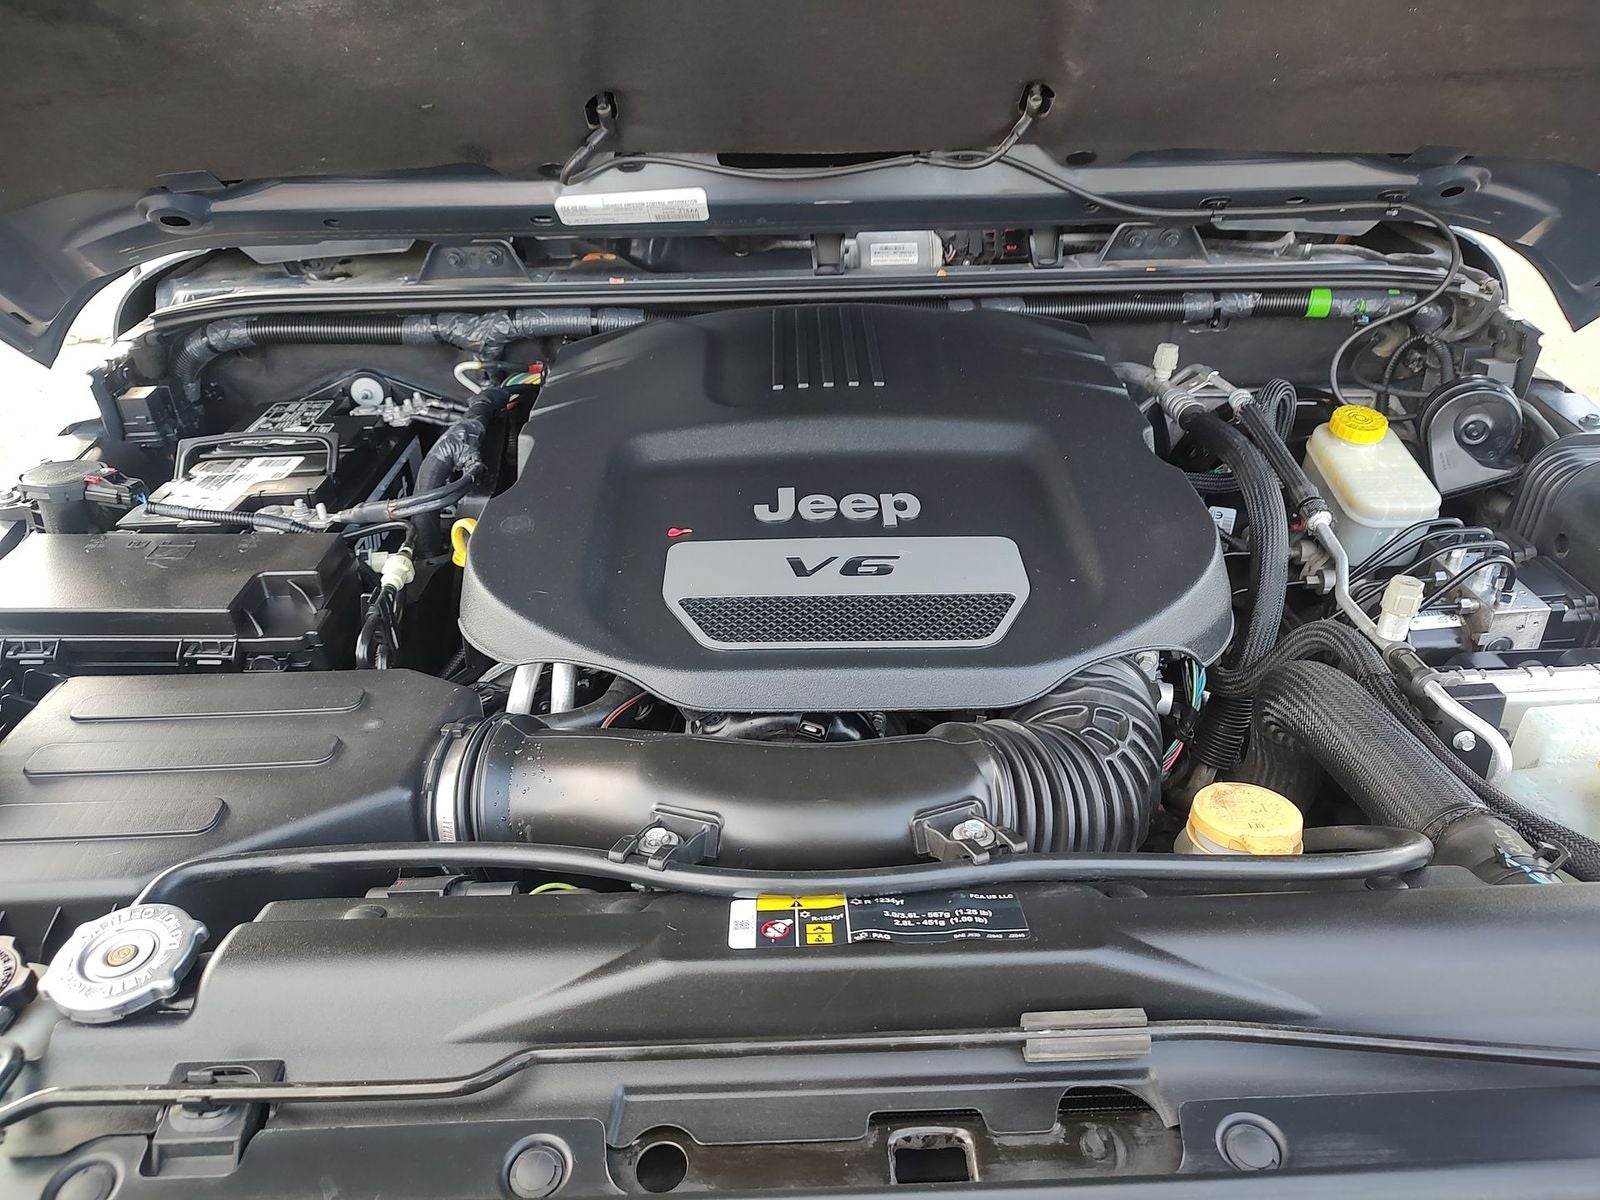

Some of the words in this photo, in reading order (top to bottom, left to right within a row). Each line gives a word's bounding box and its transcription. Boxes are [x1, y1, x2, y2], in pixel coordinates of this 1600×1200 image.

[753, 486, 922, 528] Jeep
[785, 555, 901, 578] V6
[883, 910, 920, 919] 3.0/3.6L
[927, 911, 951, 919] 567g
[954, 908, 978, 917] (1.25
[979, 909, 993, 918] lb)
[921, 919, 946, 927] 451g
[949, 915, 974, 925] (1.00
[974, 916, 988, 925] lb)
[872, 932, 891, 940] PAG
